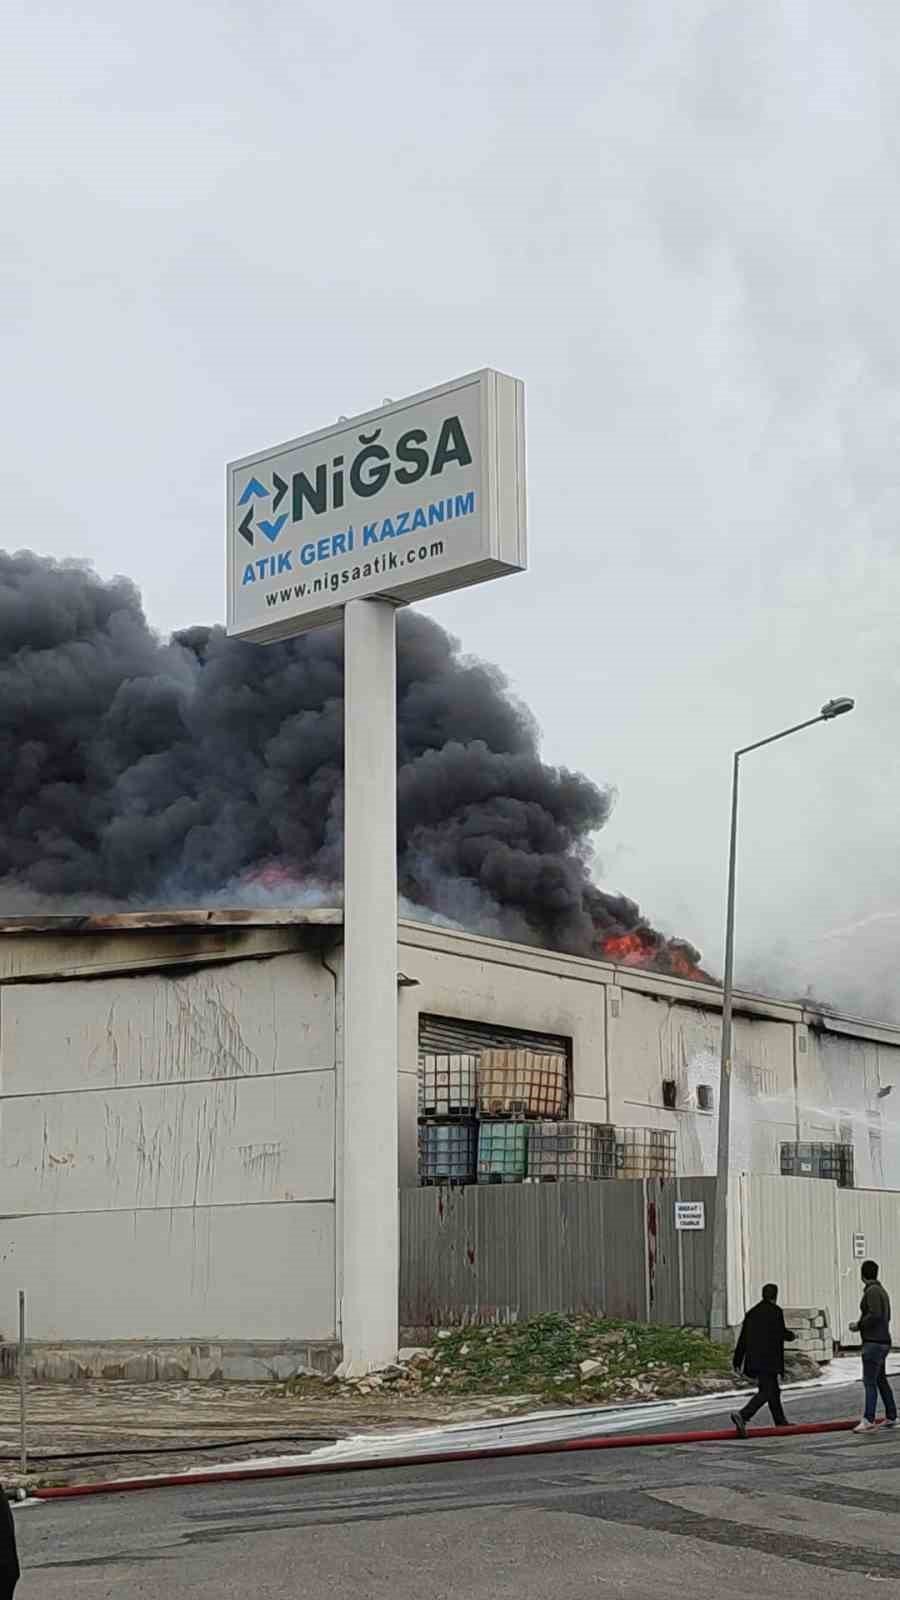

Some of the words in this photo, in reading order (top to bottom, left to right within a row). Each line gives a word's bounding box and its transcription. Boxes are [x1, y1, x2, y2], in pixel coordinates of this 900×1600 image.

[242, 550, 292, 585] ATIK
[300, 525, 353, 566] GERİ
[363, 491, 475, 547] KAZANIM
[266, 540, 443, 607] www.nigsaatik.com
